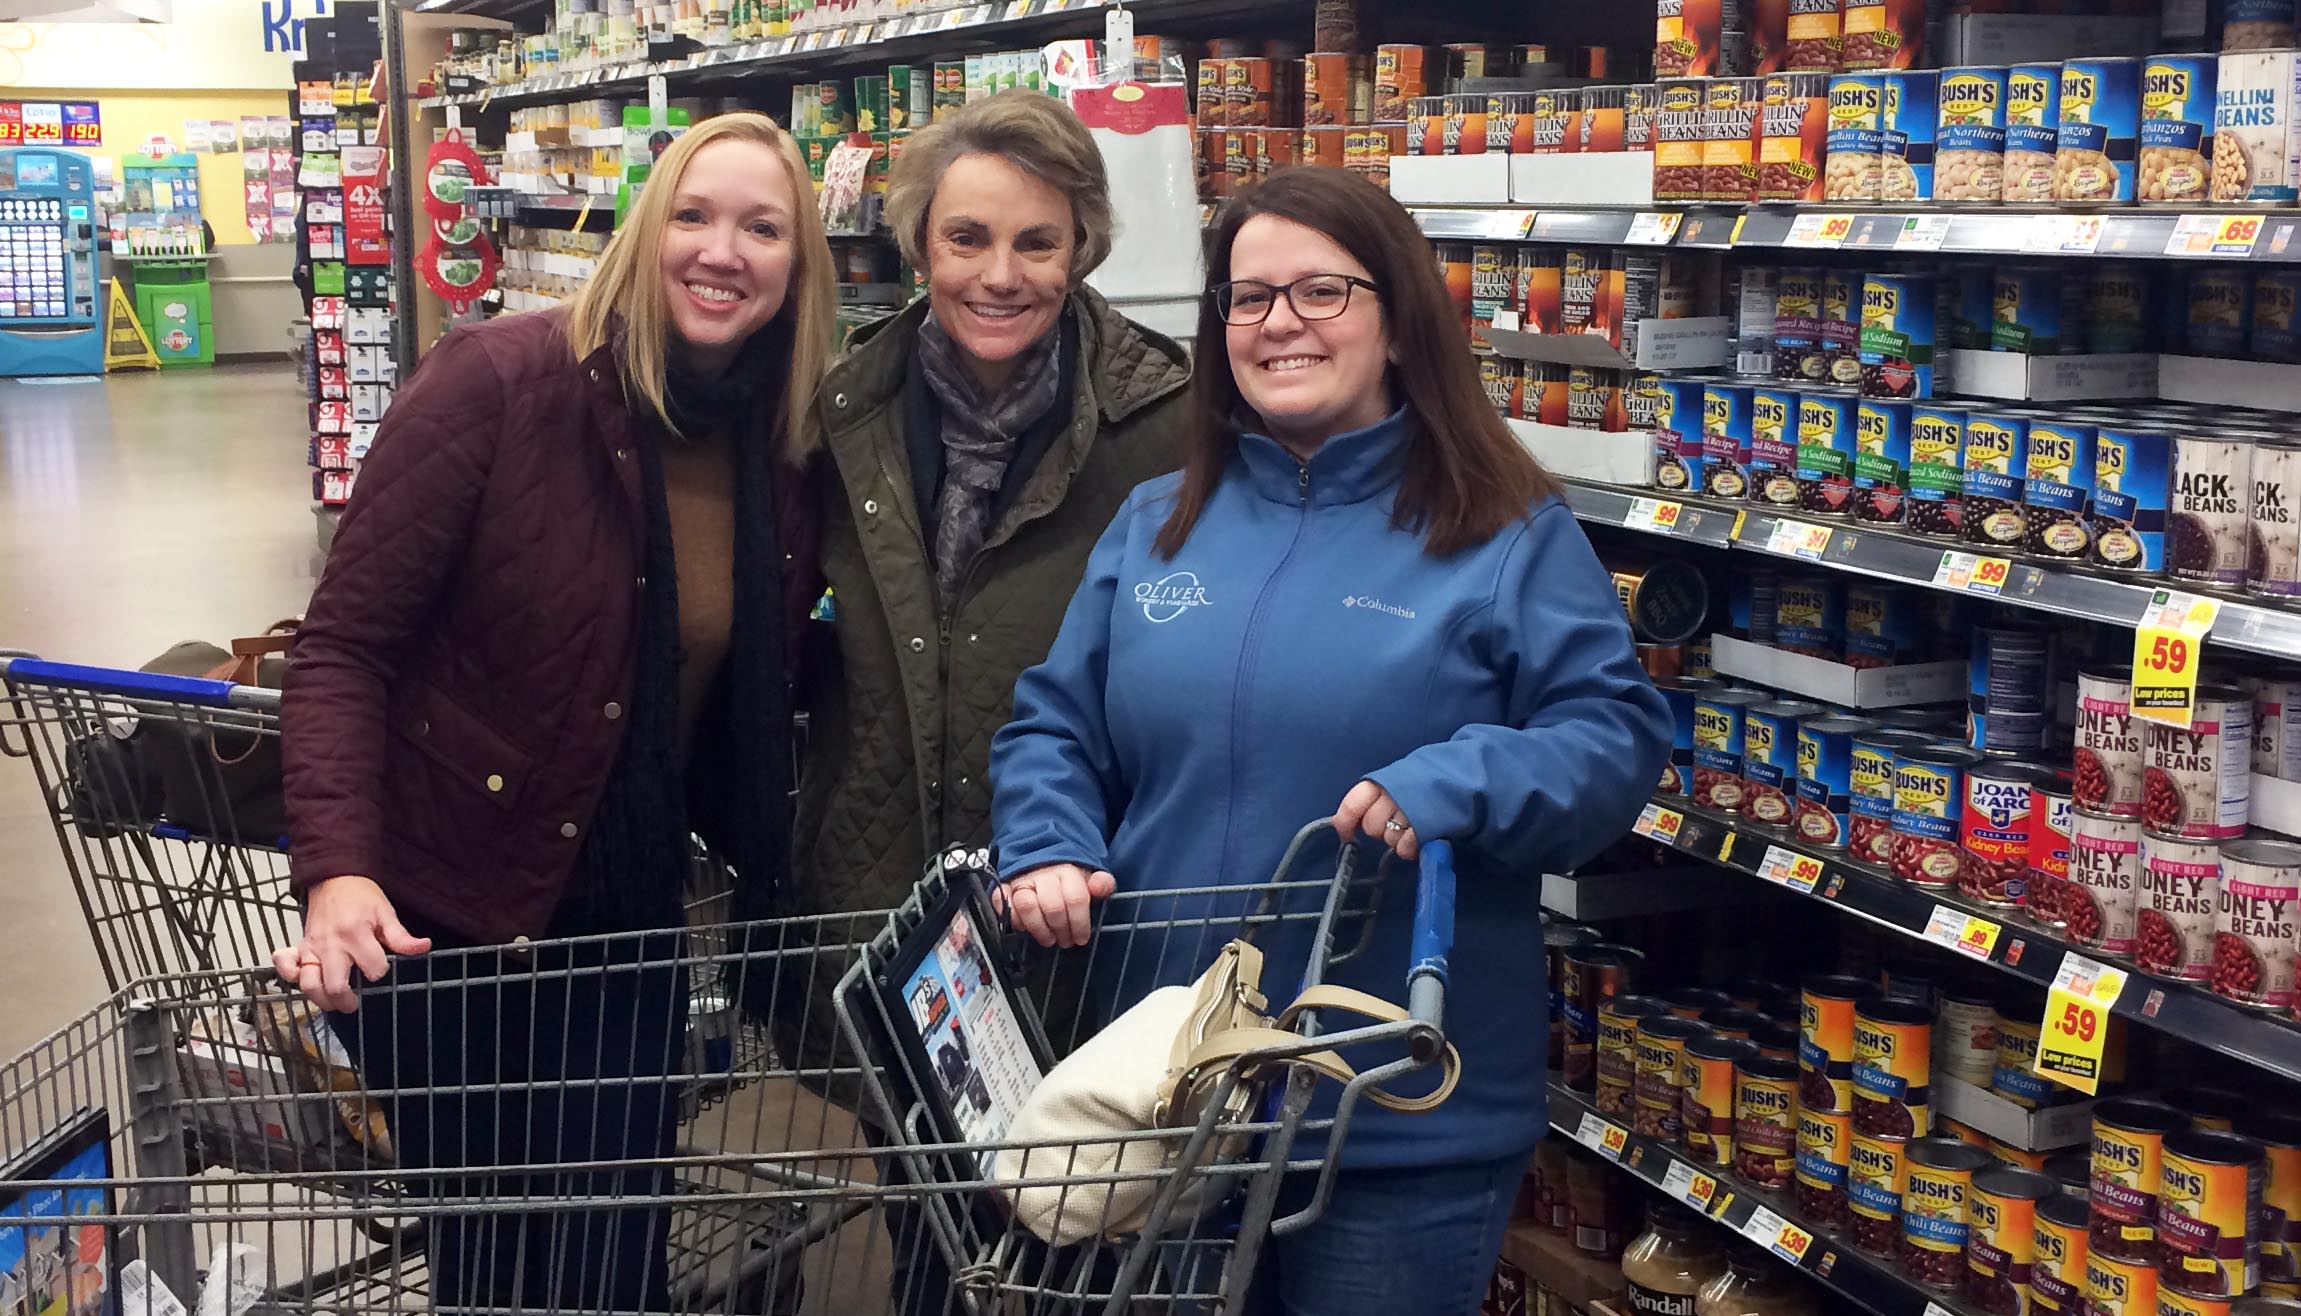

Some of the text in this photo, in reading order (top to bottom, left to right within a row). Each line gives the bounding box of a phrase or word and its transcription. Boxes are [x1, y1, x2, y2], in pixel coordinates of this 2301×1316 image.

[1674, 39, 1696, 57] NEW!
[1874, 31, 1901, 47] NEW!
[1665, 92, 1697, 104] BUSH'S
[1830, 89, 1877, 109] BUSH'S
[1941, 83, 1995, 104] BUSH'S
[2217, 107, 2275, 127] BEANS
[25, 123, 60, 139] 229
[70, 124, 99, 138] 190
[627, 127, 651, 136] Bowl
[1954, 127, 2003, 141] Northern
[2009, 128, 2055, 141] Northern
[1789, 162, 1816, 179] NEW!
[350, 185, 383, 206] 4X
[1820, 219, 1850, 236] .99
[2219, 220, 2258, 241] .69
[1870, 332, 1904, 347] Sodium
[1711, 438, 1736, 450] Recipe
[1764, 443, 1792, 455] Recipe
[1808, 449, 1842, 464] Sodium
[1861, 457, 1893, 473] Sodium
[1978, 473, 2013, 488] Beans
[2038, 482, 2075, 498] Beans
[1654, 505, 1677, 522] .99
[2184, 496, 2237, 514] BEANS
[1974, 561, 2006, 582] .99
[1135, 583, 1214, 605] OLIVER
[1356, 596, 1416, 619] Columbia
[2144, 636, 2187, 673] .59
[2135, 688, 2185, 699] Low prices
[2086, 699, 2110, 711] LIGHT
[2085, 732, 2139, 753] BEANS
[2155, 753, 2212, 772] BEANS
[1895, 770, 1946, 796] BUSH'S
[1973, 782, 2032, 797] JOAN
[1903, 791, 1928, 799] BEST
[1973, 797, 2032, 810] of ARC
[1656, 812, 1679, 833] .99
[1918, 820, 1951, 833] Beans
[1966, 836, 2001, 854] Kidney
[2078, 834, 2125, 852] LIGHT RED
[1792, 860, 1819, 880] .99
[2154, 861, 2205, 875] LIGHT RED
[2077, 868, 2130, 889] BEANS
[2232, 882, 2287, 898] LIGHT RED
[2153, 894, 2211, 914] BEANS
[2231, 919, 2293, 939] BEANS
[2054, 1002, 2096, 1042] .59
[1855, 1029, 1892, 1054] USH'S
[2042, 1050, 2092, 1069] Low prices
[1863, 1070, 1897, 1088] Beans
[1741, 1087, 1789, 1110] BUSH'S
[1604, 1127, 1623, 1147] 1.39
[1804, 1157, 1839, 1177] Beans
[1692, 1174, 1713, 1199] 1.39
[1909, 1175, 1964, 1202] BUSH'S
[2104, 1181, 2147, 1207] Beans
[1863, 1188, 1899, 1208] Beans
[1929, 1220, 1968, 1237] Beans
[2168, 1213, 2208, 1237] Beans
[1778, 1226, 1807, 1254] 1.39
[2032, 1271, 2068, 1297] Beans
[1628, 1284, 1694, 1316] Randall
